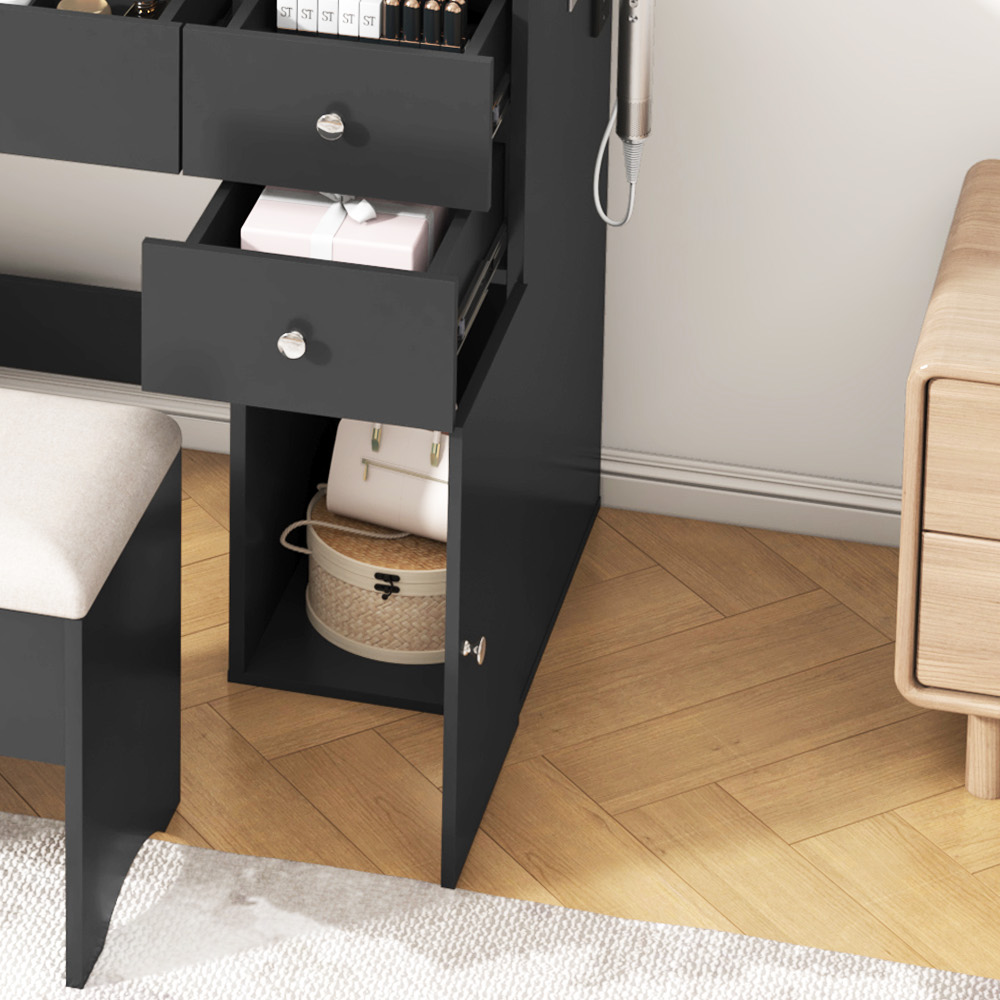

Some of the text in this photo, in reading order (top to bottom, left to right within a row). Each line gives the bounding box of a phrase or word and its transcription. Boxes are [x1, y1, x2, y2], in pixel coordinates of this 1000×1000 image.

[280, 7, 293, 17] ST
[301, 9, 313, 20] ST
[322, 11, 334, 22] ST
[342, 13, 355, 24] ST
[363, 15, 376, 26] ST
